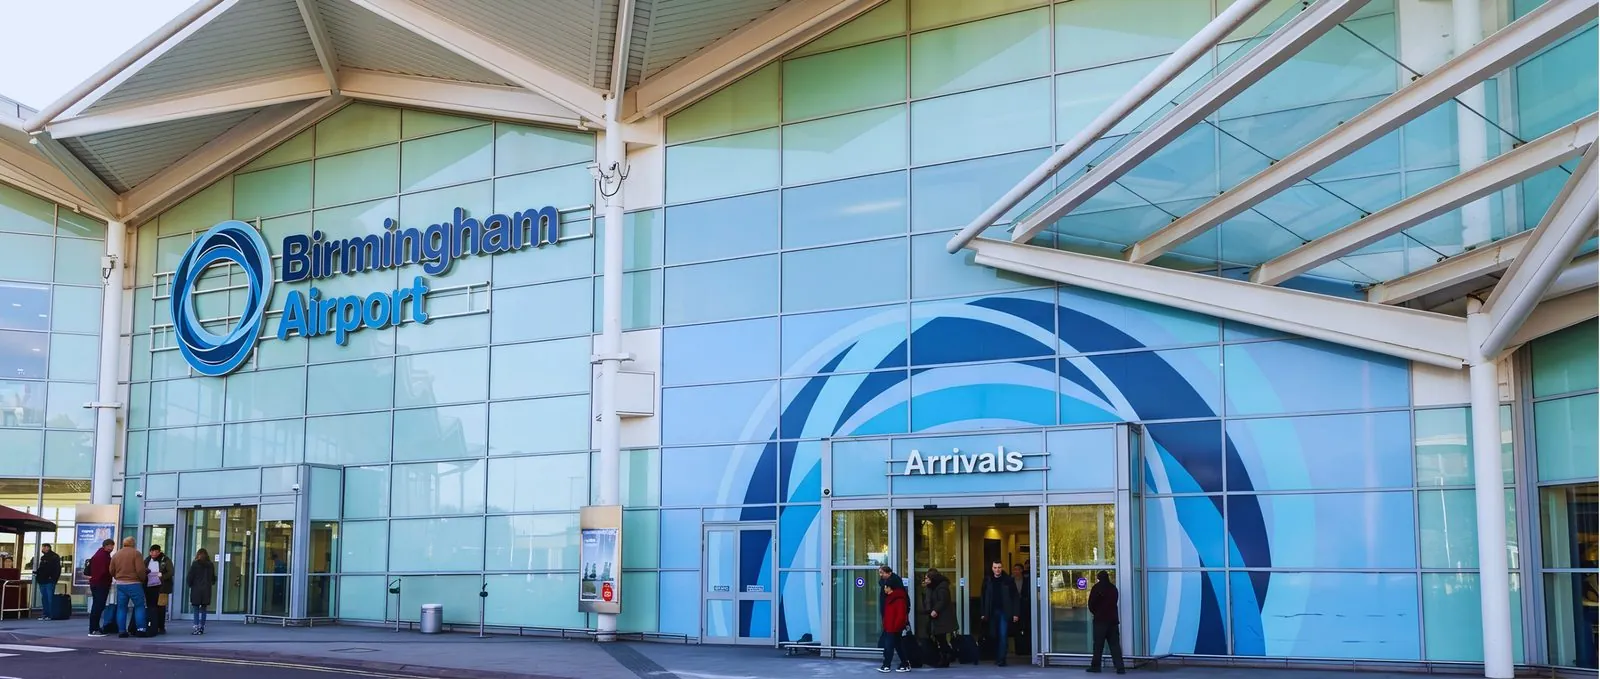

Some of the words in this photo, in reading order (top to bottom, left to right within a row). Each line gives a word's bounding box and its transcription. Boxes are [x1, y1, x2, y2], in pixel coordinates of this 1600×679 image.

[281, 205, 560, 283] Birmingham
[277, 276, 429, 346] Airport
[904, 446, 1024, 475] Arrivals
